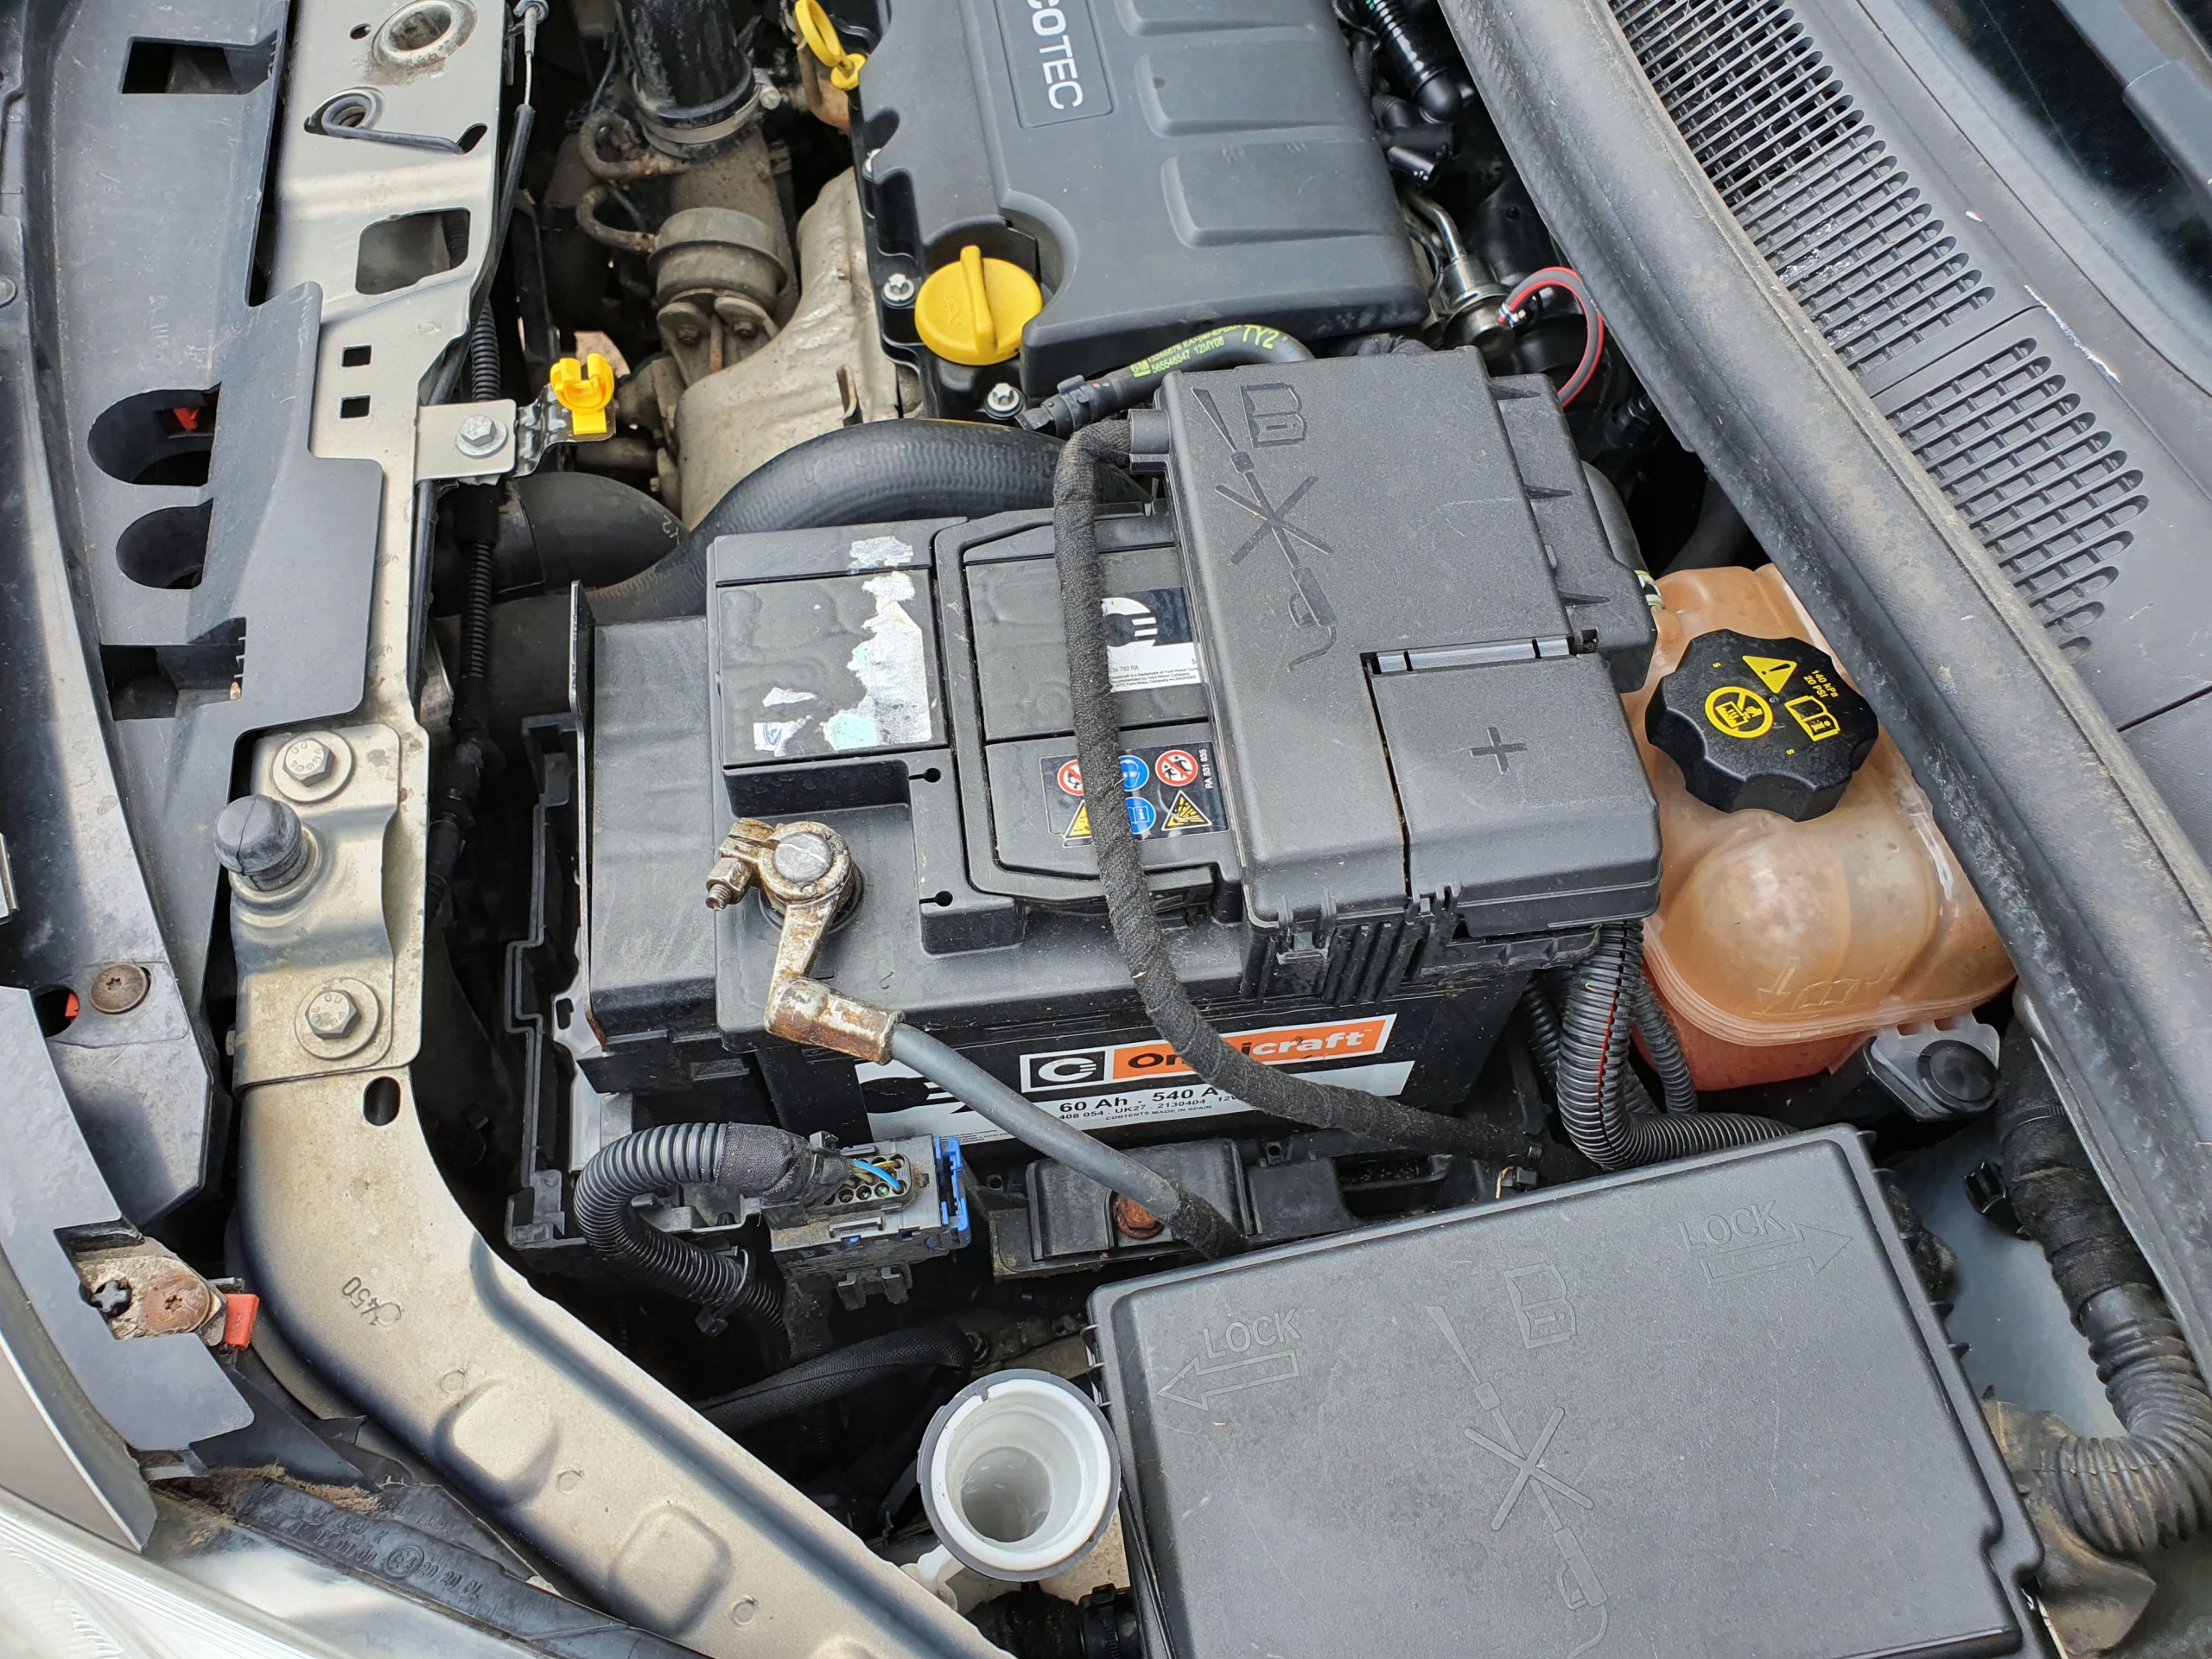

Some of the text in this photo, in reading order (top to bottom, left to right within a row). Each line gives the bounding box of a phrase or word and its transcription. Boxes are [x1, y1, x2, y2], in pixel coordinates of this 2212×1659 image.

[1243, 325, 1280, 349] TY2
[1130, 359, 1150, 373] GM
[1803, 675, 1828, 698] 20 PSI
[1812, 670, 1839, 697] 140 kPa
[1201, 764, 1211, 777] 531
[1205, 778, 1213, 790] RA
[1128, 1029, 1365, 1069] Oicraft
[1059, 1101, 1087, 1113] 60
[1095, 1096, 1128, 1109] Ah
[1152, 1089, 1194, 1102] 540
[1115, 1103, 1147, 1114] UK27
[1157, 1098, 1206, 1109] 2130404
[1106, 1110, 1150, 1121] CONTENTS
[1677, 1198, 1788, 1253] LOCK
[1202, 1306, 1304, 1359] LOCK
